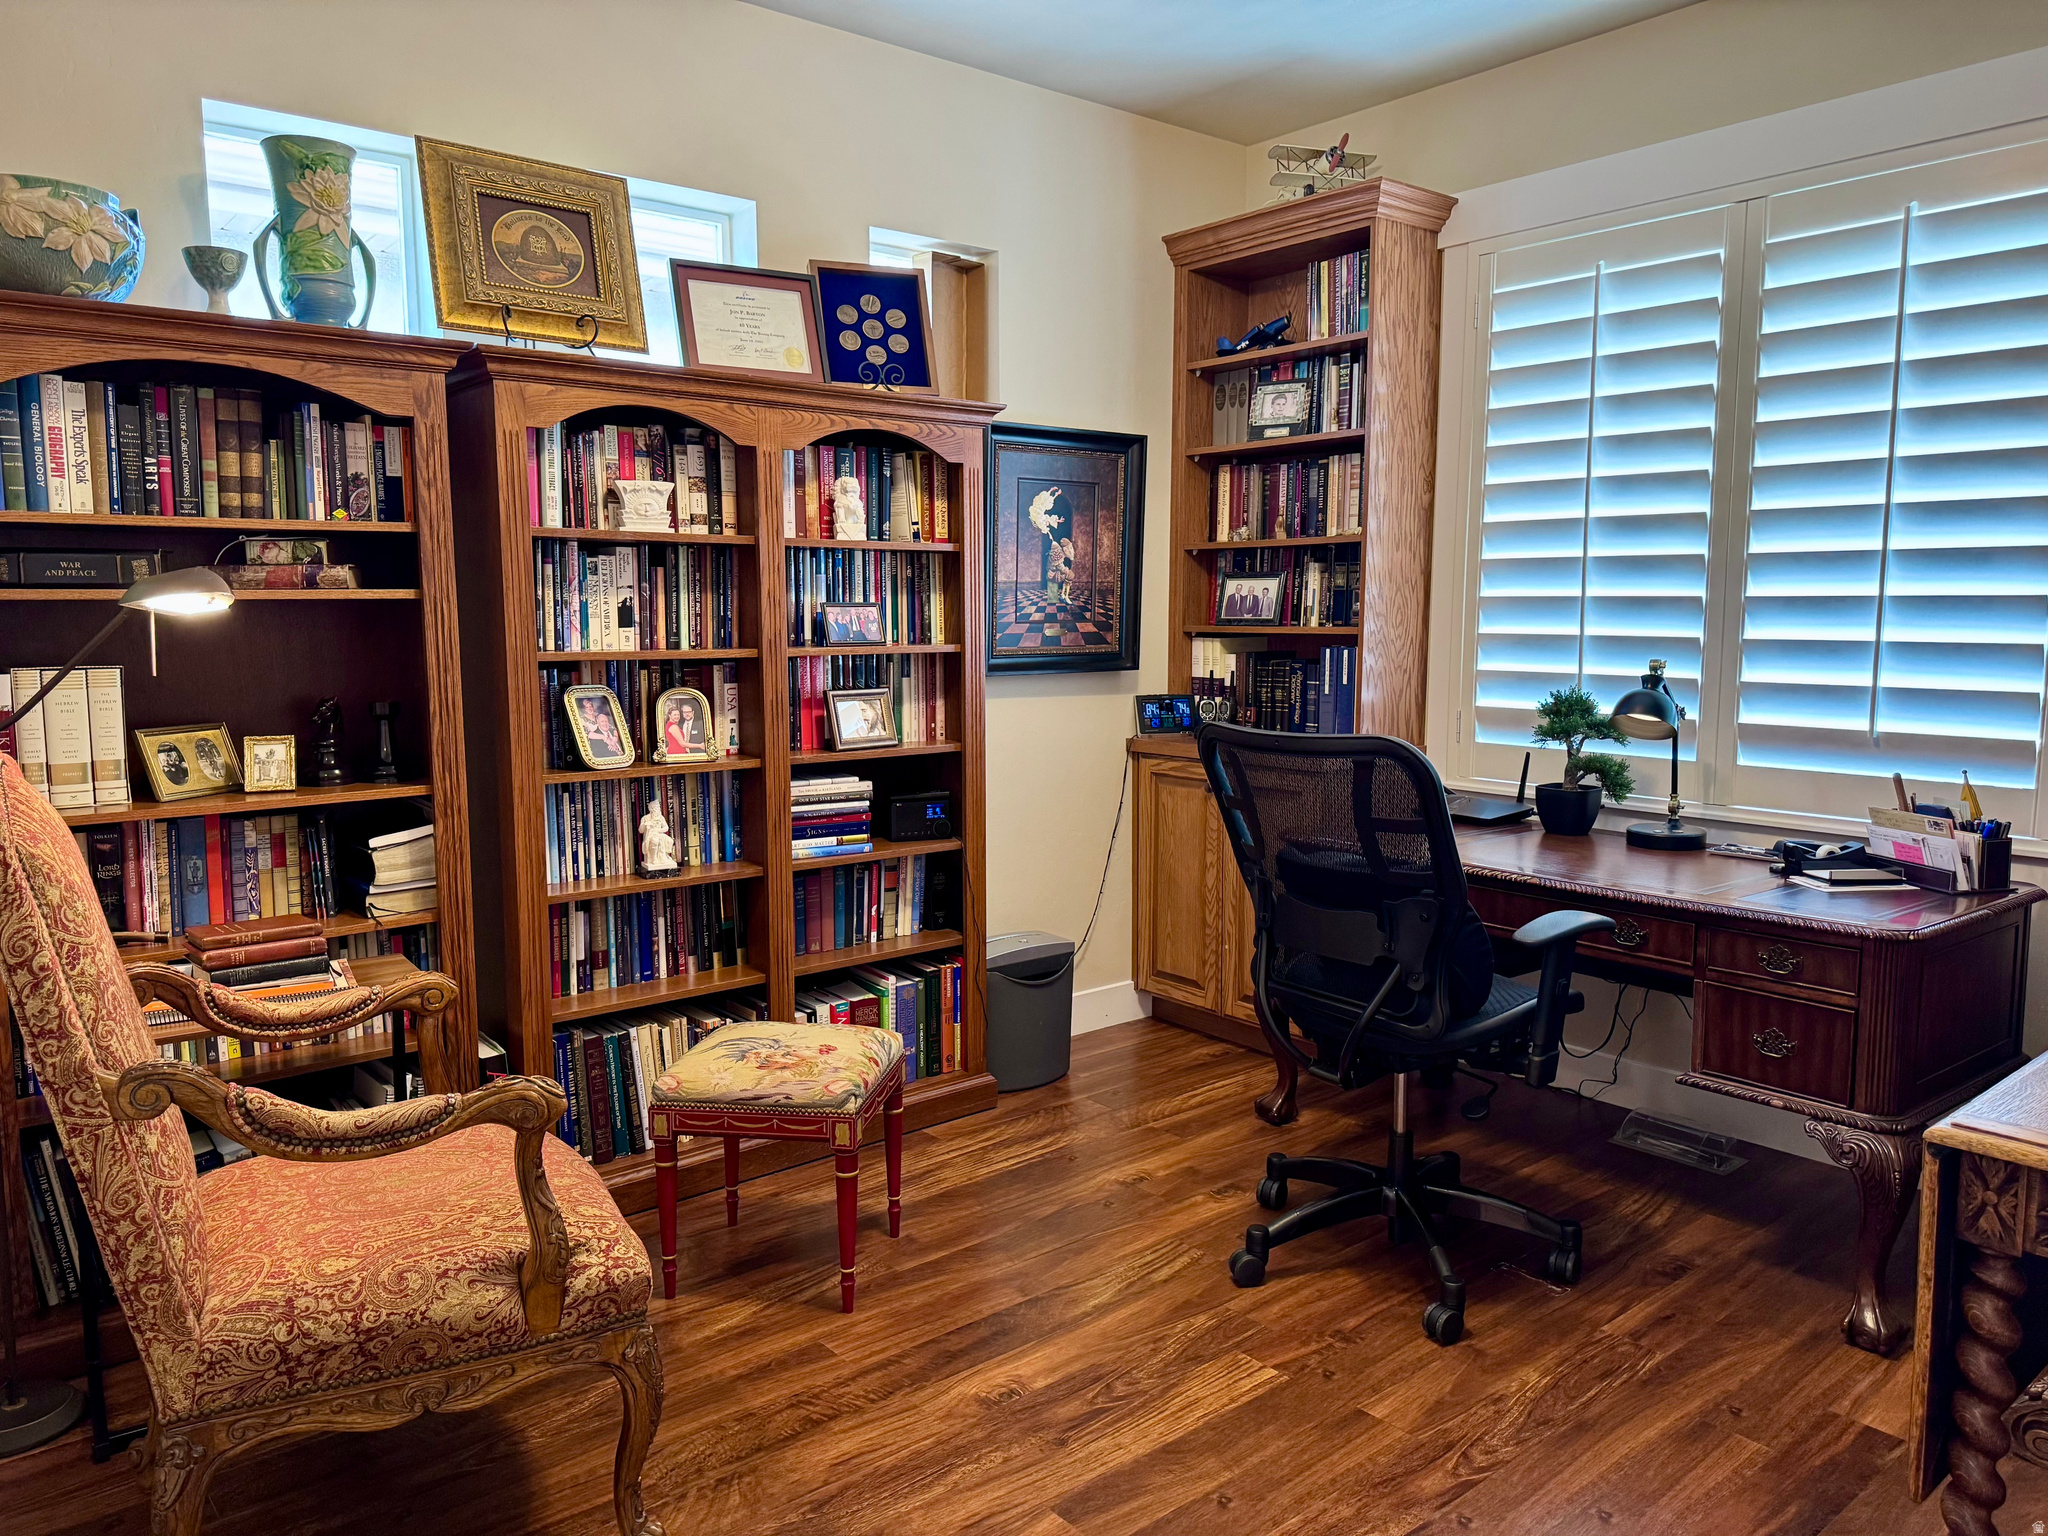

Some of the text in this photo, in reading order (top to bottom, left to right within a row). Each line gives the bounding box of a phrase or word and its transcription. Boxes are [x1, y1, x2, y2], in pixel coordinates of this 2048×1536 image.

[45, 377, 55, 425] MUCH ABOUT
[51, 378, 60, 401] DON'T
[179, 404, 188, 421] LIVES
[180, 421, 187, 431] OF
[30, 403, 46, 488] GENERAL BIOLOGY
[144, 398, 158, 490] Understanding ARTS
[332, 424, 340, 442] Oxford
[605, 427, 613, 457] COURAGE
[47, 425, 66, 480] GEOGRAPHY
[70, 409, 90, 485] The Experts Speak
[180, 437, 190, 459] GREAT
[332, 443, 341, 464] Foreign
[547, 448, 555, 470] CULTURAL
[95, 436, 108, 495] PHYSICS
[334, 463, 342, 480] Words
[375, 449, 386, 500] ENGLISH PLACE-NAMES
[652, 450, 666, 478] 1776
[678, 457, 686, 475] 1491
[695, 450, 704, 472] 1493
[182, 458, 192, 496] COMPOSERS
[1221, 469, 1229, 488] Joseph
[336, 486, 344, 505] Phrases
[922, 476, 930, 510] QUOTABLE
[939, 478, 948, 530] Quips & Quotes
[923, 510, 931, 531] POEMS
[45, 569, 97, 577] AND PEACE
[600, 559, 611, 637] RELIGIONS OF AMERICA
[725, 686, 738, 712] USA
[1294, 670, 1304, 724] American Heritage
[160, 829, 171, 876] BATTALION
[96, 870, 122, 880] RINGS
[127, 847, 136, 888] RENT COLLECTOR
[322, 855, 330, 878] STRUGGLE
[913, 892, 921, 903] Day
[855, 1007, 879, 1016] MERCK
[855, 1014, 879, 1022] MANUAL
[899, 1000, 907, 1034] DICTIONARY
[906, 999, 915, 1033] MOSBY'S
[607, 1044, 615, 1062] CHURCH
[567, 1071, 579, 1120] ANCIENT AMERICA
[574, 1050, 590, 1150] REMARKABLE BOOKS
[38, 1176, 78, 1292] THE MORMON TABERNACLE CHOIR
